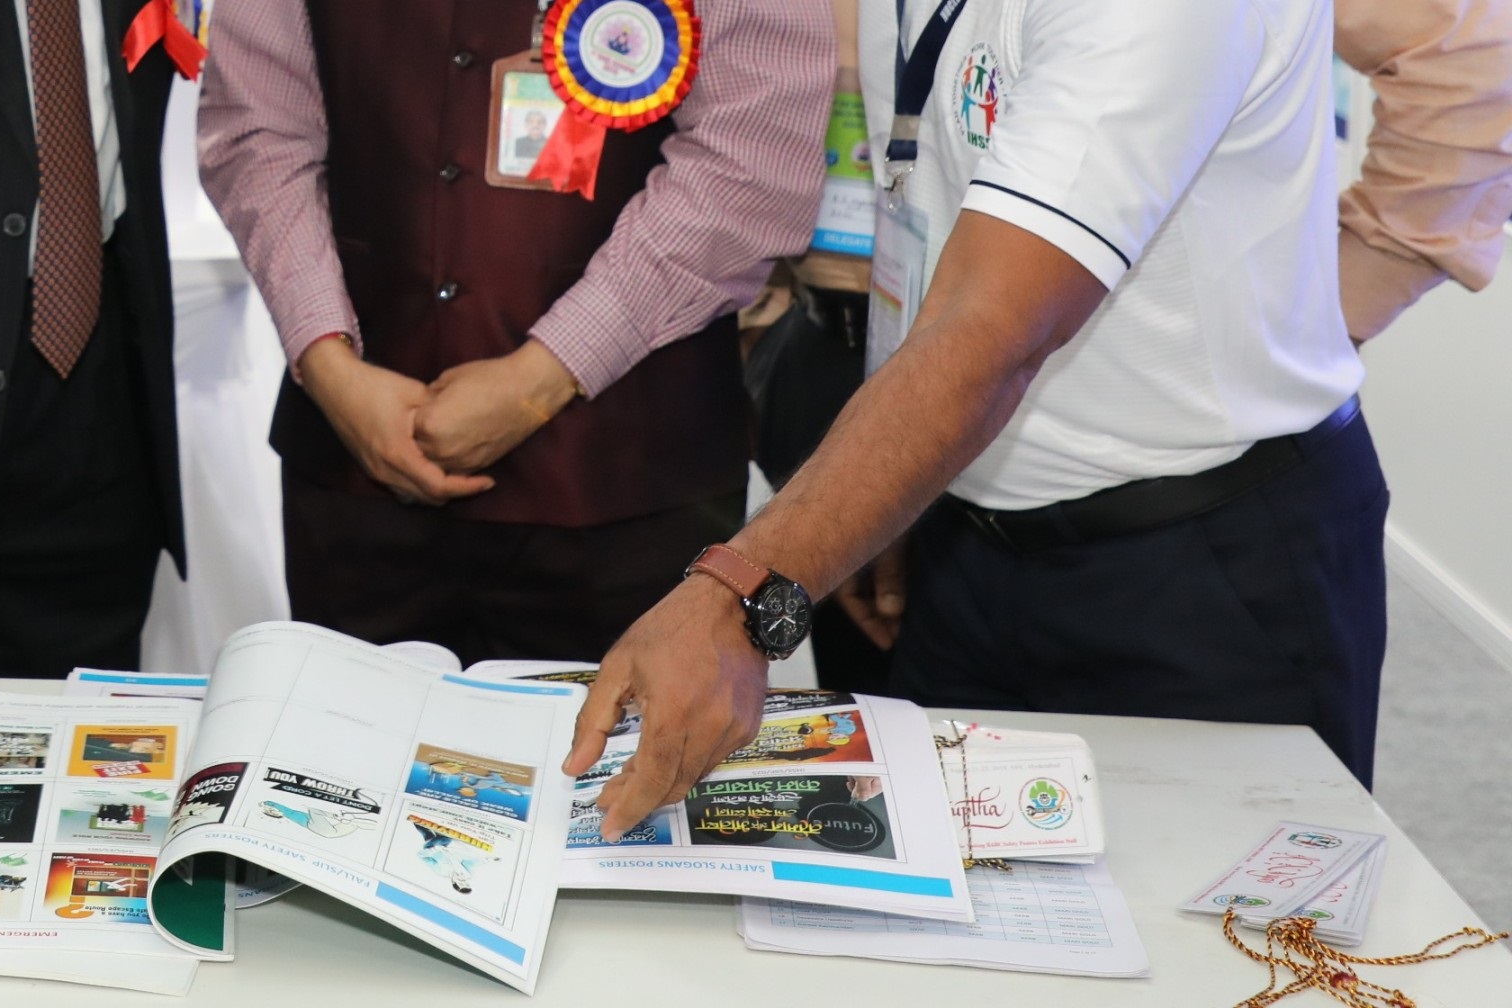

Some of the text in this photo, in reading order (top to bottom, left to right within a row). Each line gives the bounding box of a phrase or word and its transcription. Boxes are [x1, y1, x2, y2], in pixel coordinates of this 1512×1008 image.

[193, 774, 239, 791] DOWN
[300, 775, 356, 799] THROW
[204, 834, 371, 888] FALL/SLIP SAFETY POSTERS
[598, 860, 766, 873] SAFETY SLOGANS POSTERS
